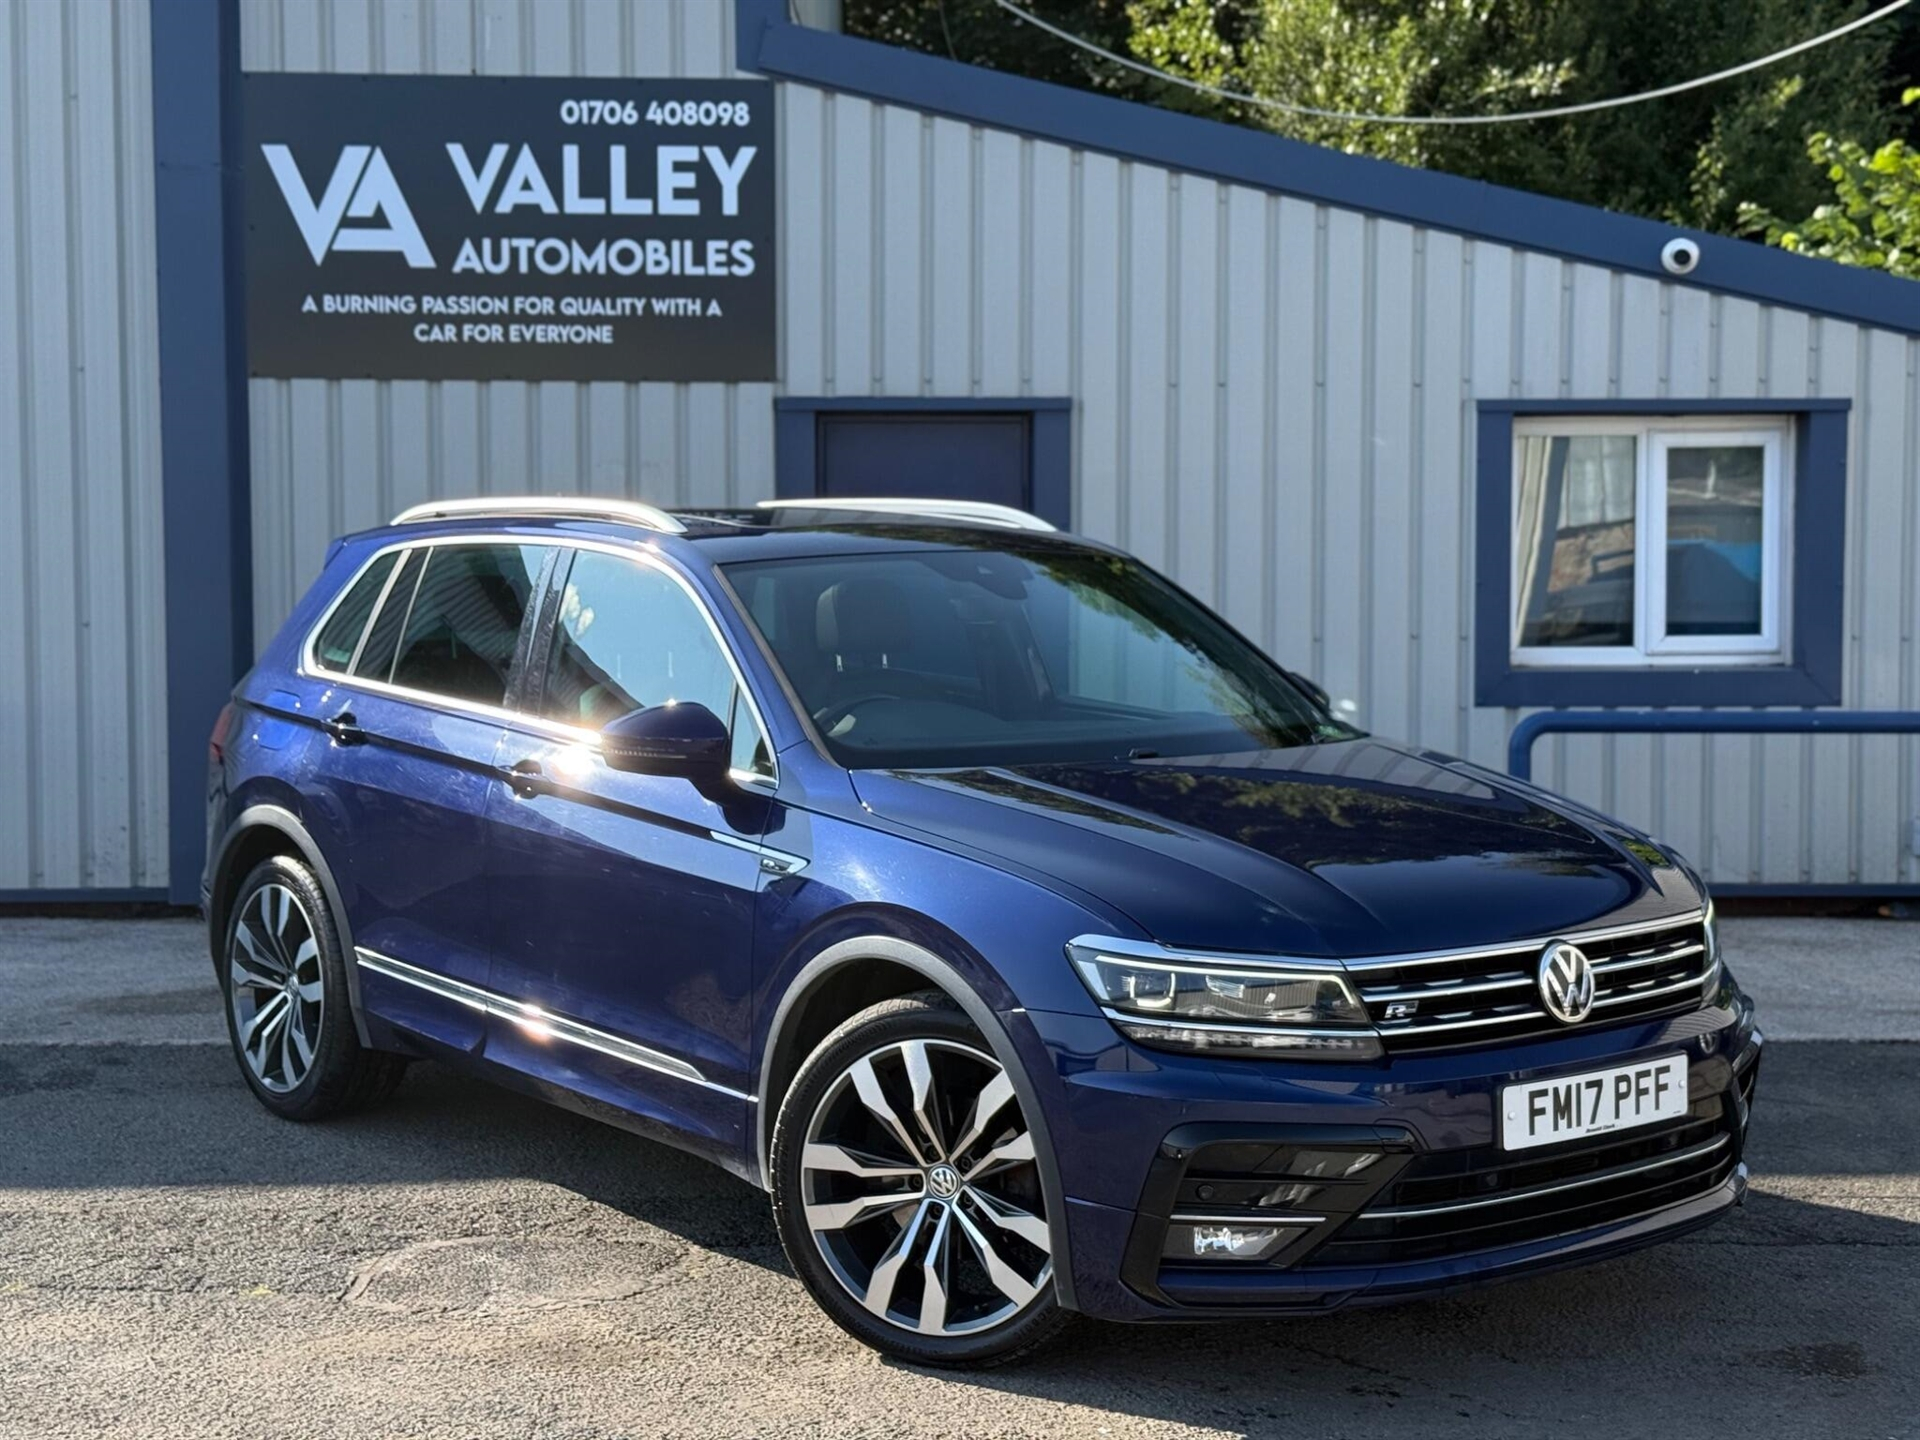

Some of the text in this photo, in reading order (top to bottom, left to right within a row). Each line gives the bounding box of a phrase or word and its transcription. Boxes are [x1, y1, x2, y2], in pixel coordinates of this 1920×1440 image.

[560, 99, 750, 127] 01706 408098
[445, 142, 758, 216] VALLEY
[260, 143, 438, 268] VA
[452, 237, 756, 277] AUTOMOBILES
[302, 294, 722, 317] A BURNING PASSION FOR QUALITY WITH A
[413, 323, 614, 345] CAR FOR EVERYONE
[1527, 1064, 1671, 1137] FM17 PFF
